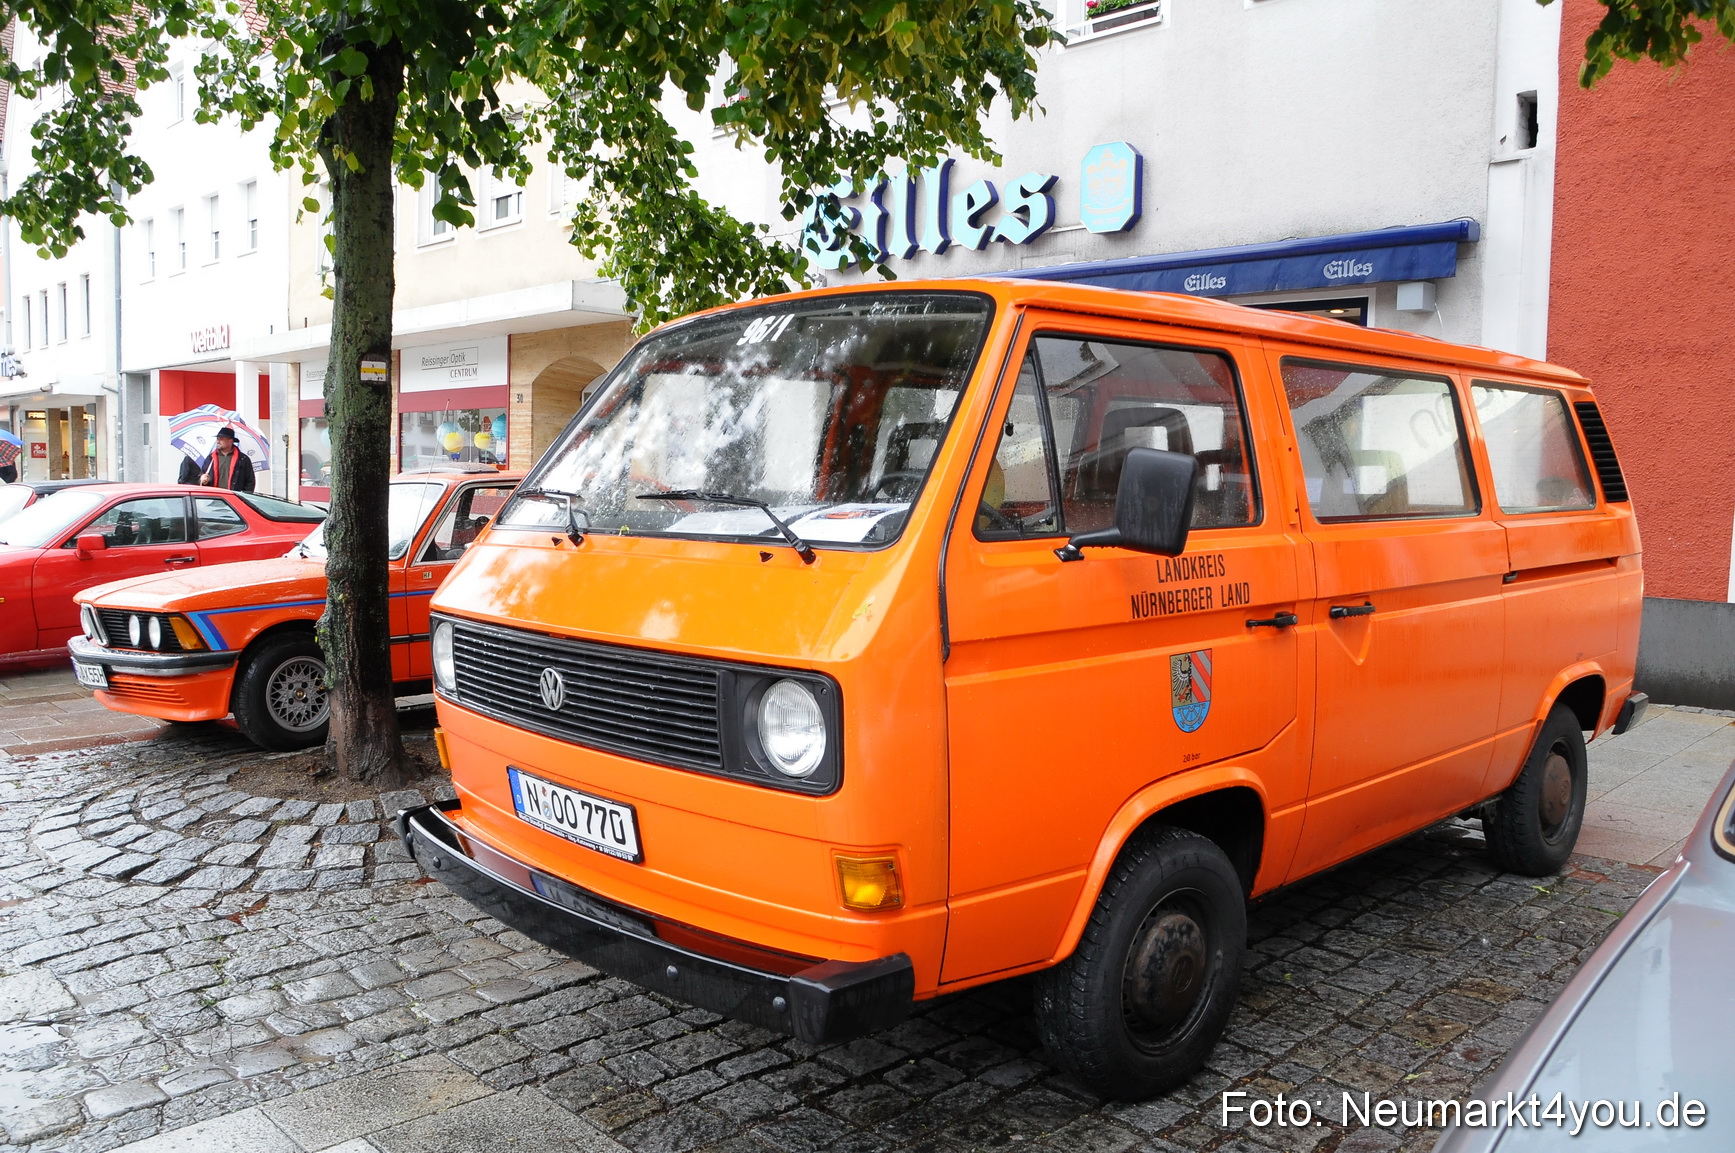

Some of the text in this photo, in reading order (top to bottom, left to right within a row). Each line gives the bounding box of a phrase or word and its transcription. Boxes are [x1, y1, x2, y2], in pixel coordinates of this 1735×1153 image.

[801, 157, 1059, 270] Eilles
[1183, 272, 1227, 292] Eilles
[1323, 258, 1374, 279] Eilles
[736, 313, 796, 346] 96/1
[422, 352, 466, 367] Reissinger Optik
[449, 367, 478, 379] CENTRUM
[1156, 553, 1226, 584] LANDKREIS
[1130, 582, 1251, 619] NÜRNBERGER LAND
[580, 799, 626, 846] 770
